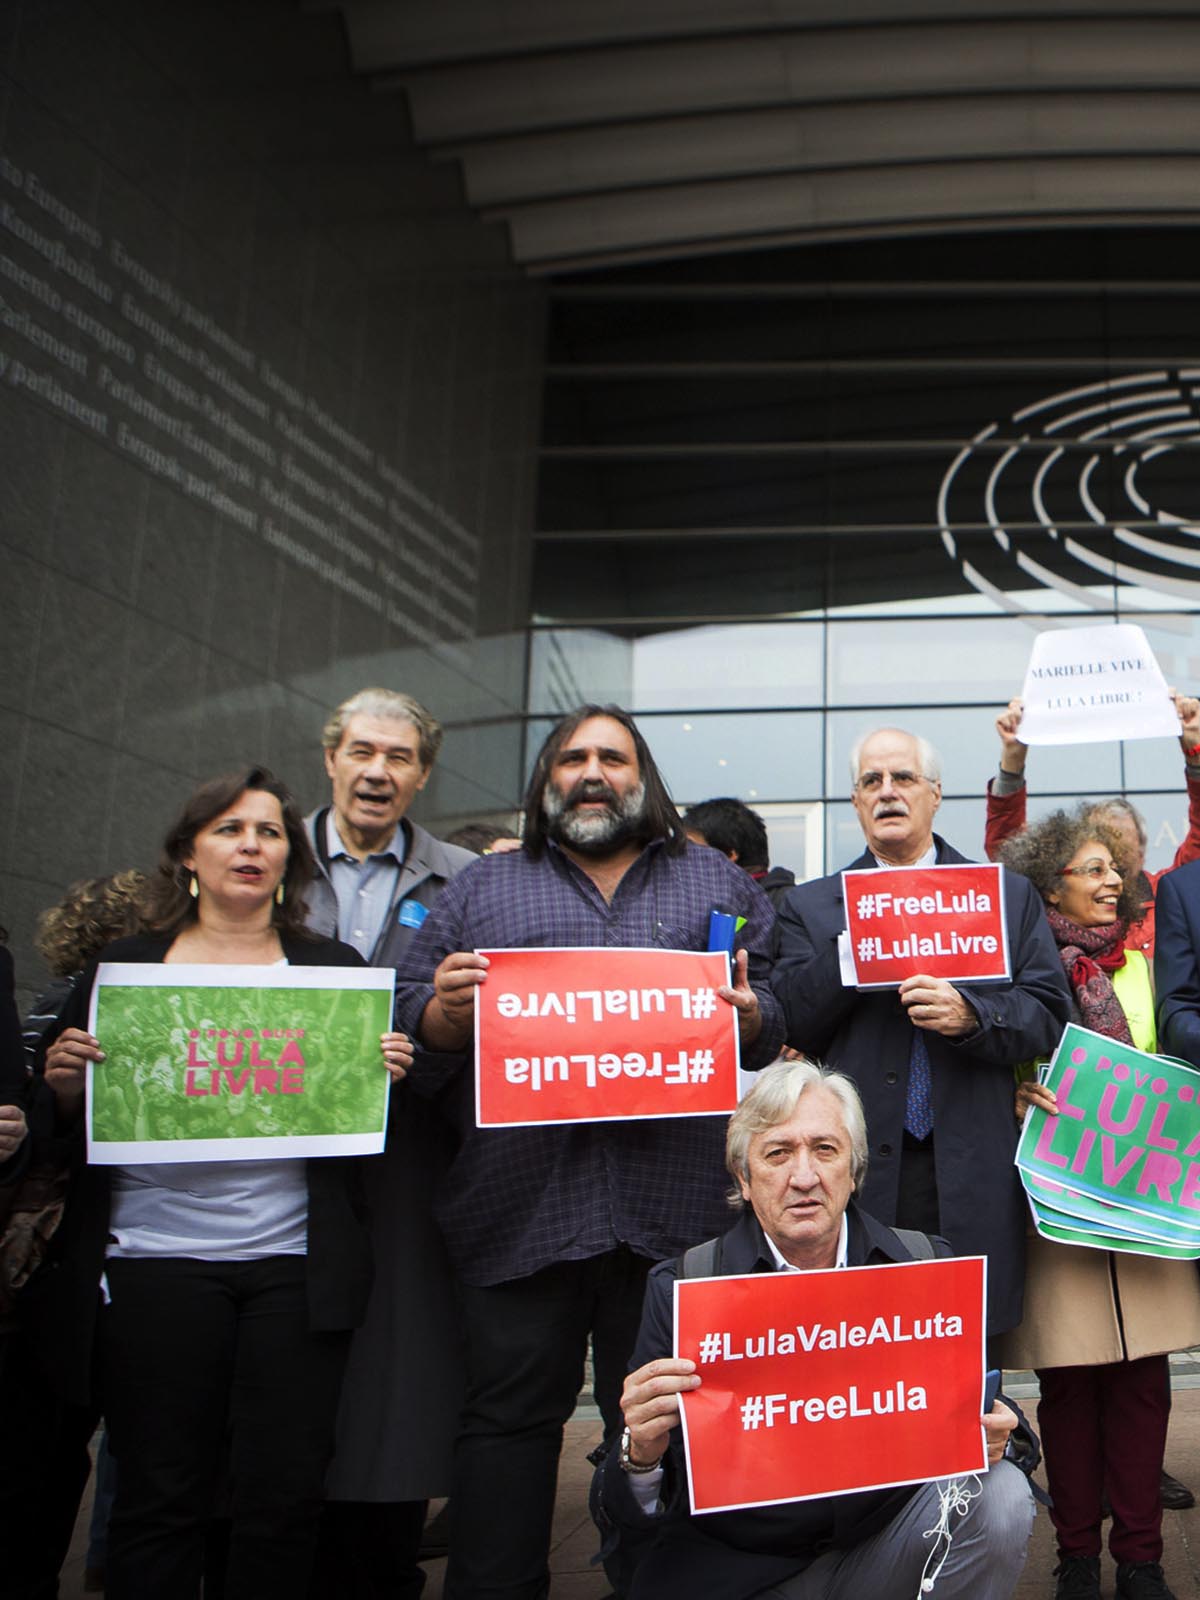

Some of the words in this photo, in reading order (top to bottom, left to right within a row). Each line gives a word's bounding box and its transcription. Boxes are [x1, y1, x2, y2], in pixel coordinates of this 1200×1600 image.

[1031, 664, 1106, 679] MARIELLE
[1111, 659, 1146, 672] VIVE
[857, 889, 991, 920] #FreeLula
[857, 931, 998, 962] #LulaLivre
[497, 986, 717, 1023] #LulaLivre
[187, 1040, 305, 1067] LULA
[504, 1049, 715, 1091] #FreeLula
[185, 1067, 305, 1097] LIVRE
[1095, 1055, 1169, 1095] POVO
[699, 1311, 963, 1364] #LulaValeALuta
[740, 1380, 928, 1431] #FreeLula
